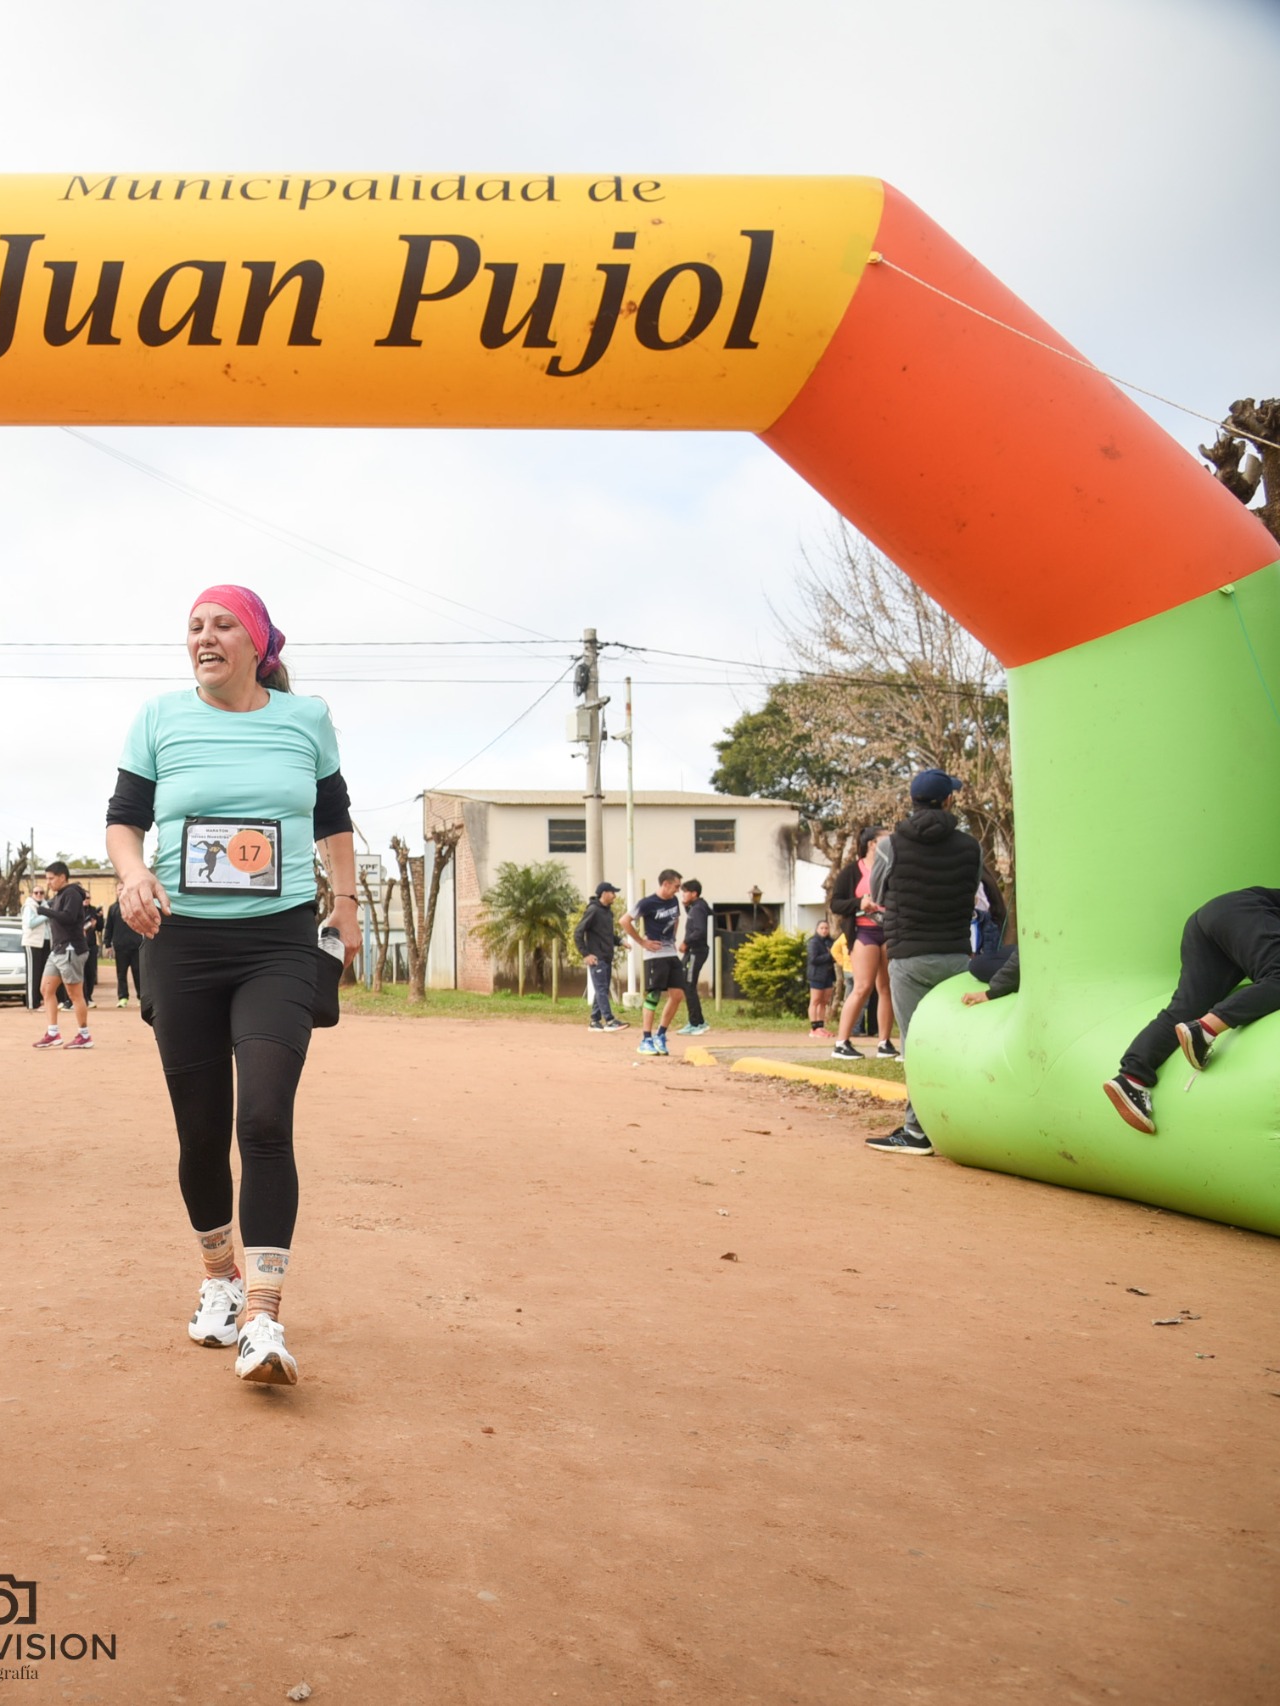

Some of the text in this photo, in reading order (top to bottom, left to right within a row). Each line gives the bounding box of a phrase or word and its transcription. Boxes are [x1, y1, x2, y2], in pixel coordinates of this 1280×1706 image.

[58, 174, 666, 210] Municipalidad de
[374, 229, 775, 378] Pujol
[239, 845, 261, 862] 17
